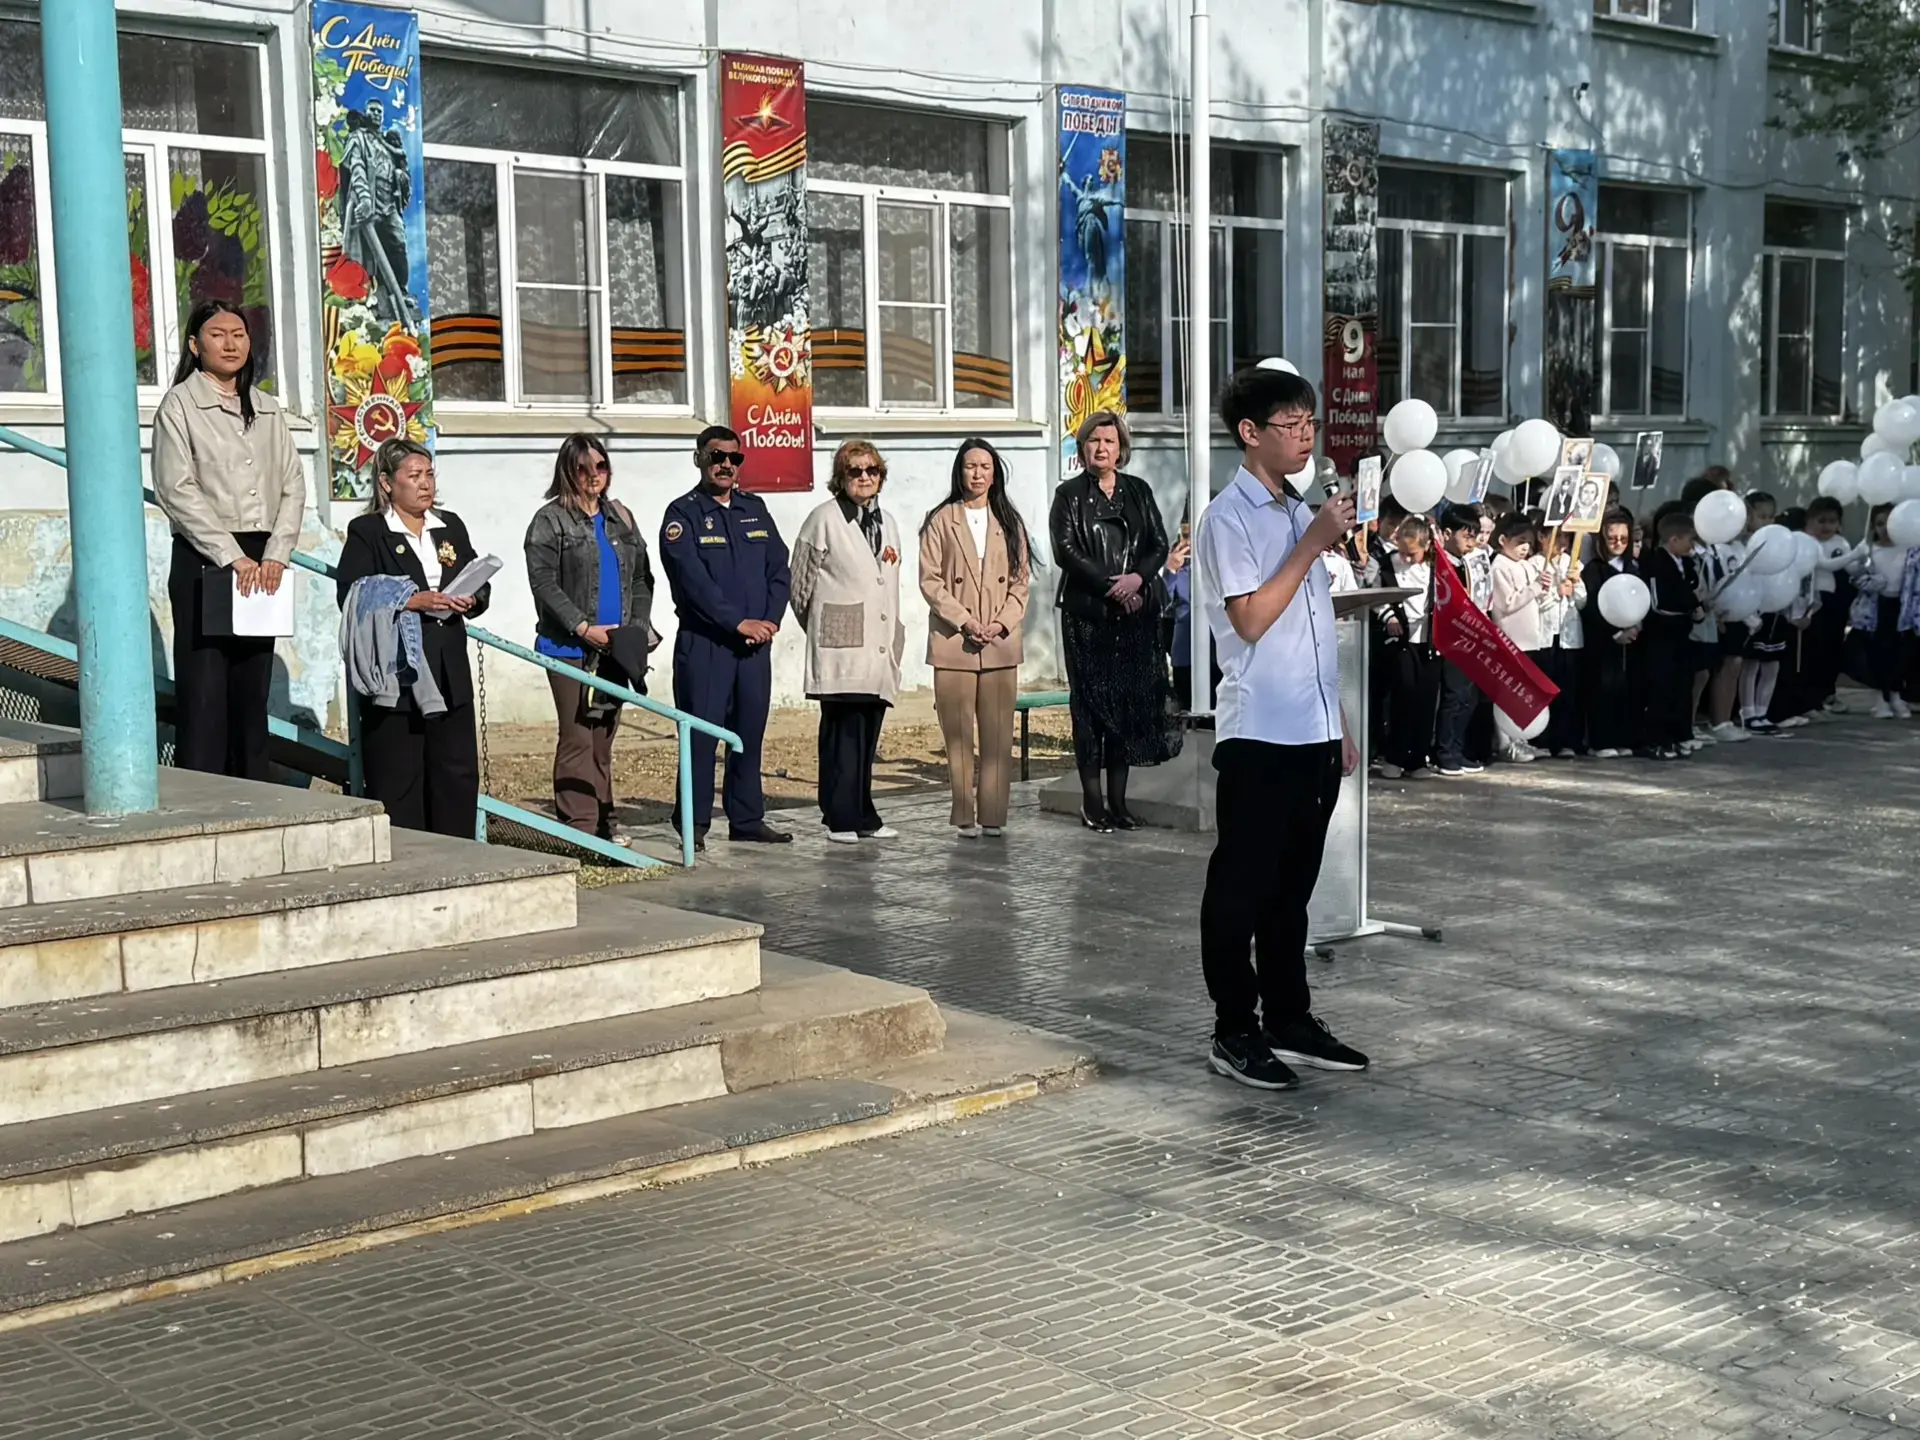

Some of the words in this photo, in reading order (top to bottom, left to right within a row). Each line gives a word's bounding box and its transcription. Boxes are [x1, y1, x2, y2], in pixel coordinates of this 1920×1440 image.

[320, 15, 350, 49] С
[341, 49, 415, 91] Победы!
[728, 71, 767, 85] ВЕЛИКОГО
[1062, 94, 1070, 105] С
[1343, 319, 1365, 364] 9
[1332, 387, 1341, 403] С
[747, 404, 761, 425] С
[761, 404, 802, 426] Днём
[741, 426, 805, 449] Победы!
